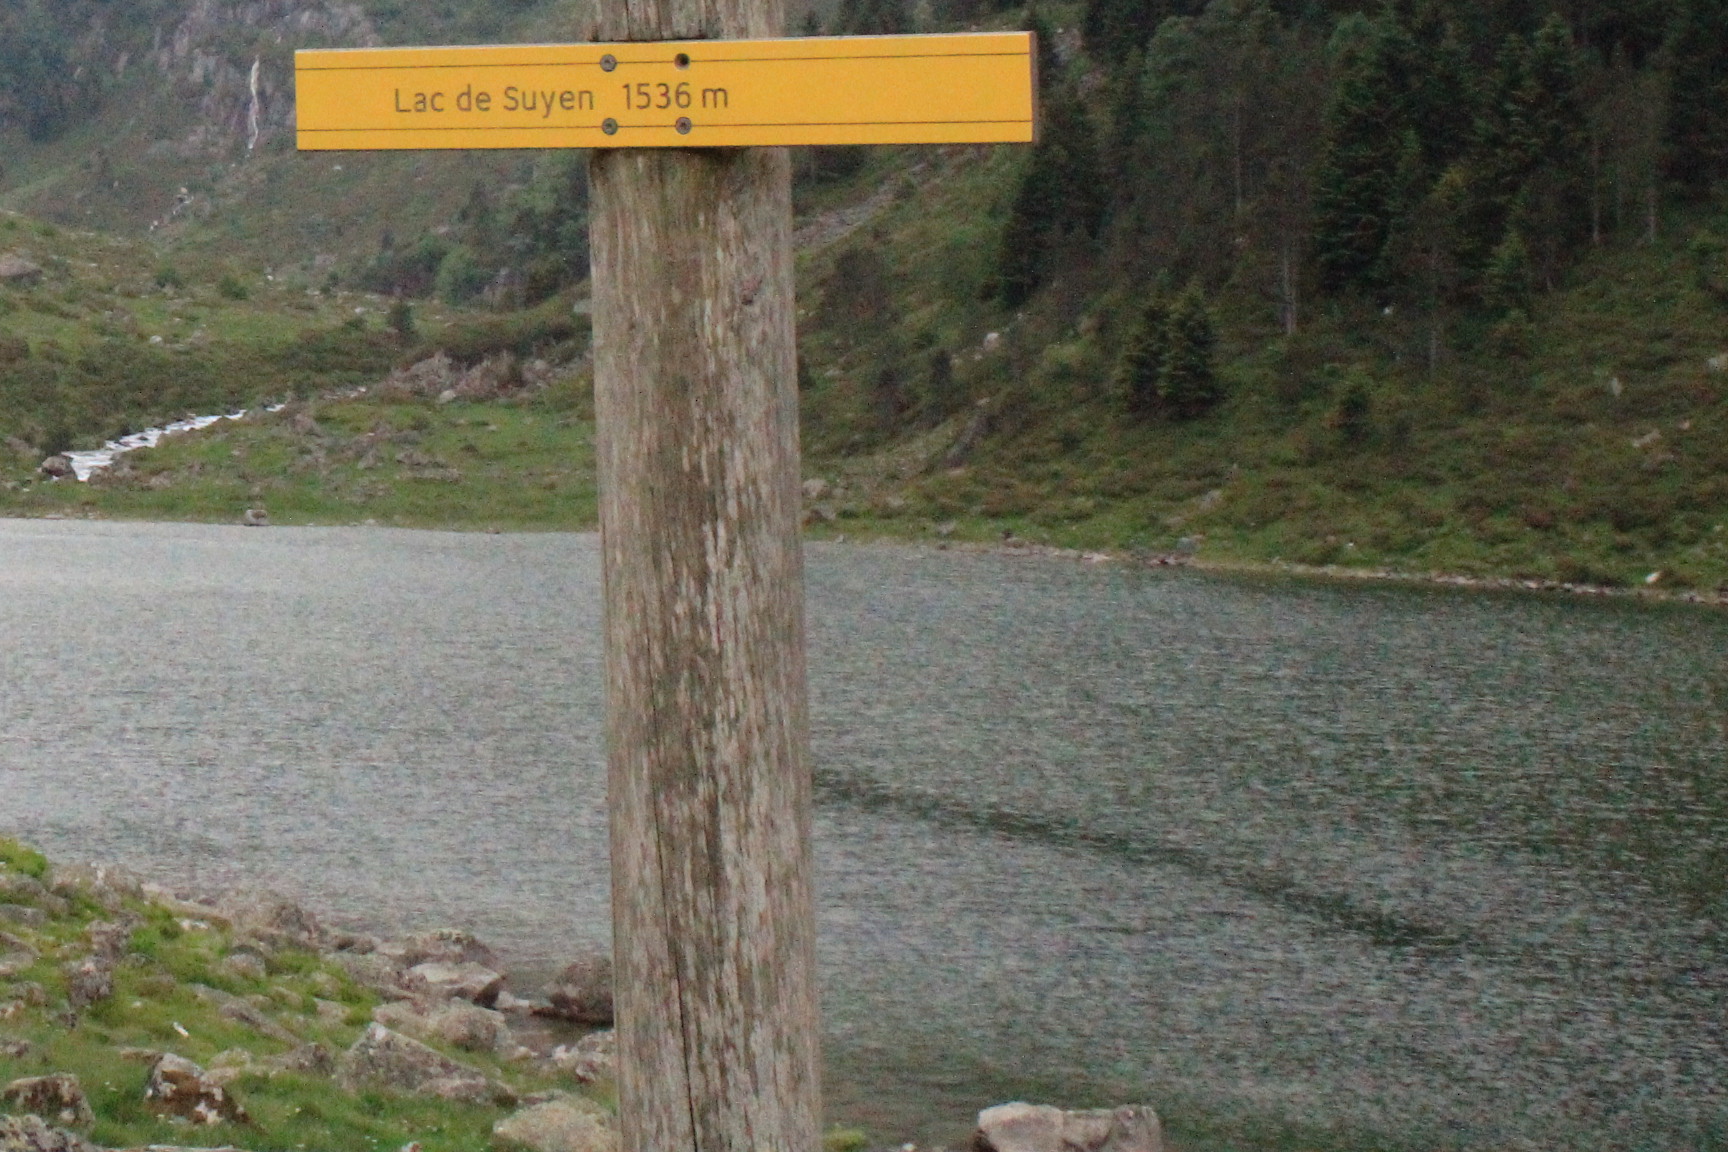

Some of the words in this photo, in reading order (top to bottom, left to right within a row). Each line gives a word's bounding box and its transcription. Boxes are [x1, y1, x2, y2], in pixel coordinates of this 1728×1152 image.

[394, 87, 445, 113] Lac
[456, 84, 492, 112] de
[503, 85, 595, 119] Suyen
[622, 82, 692, 110] 1536
[702, 86, 729, 108] m
